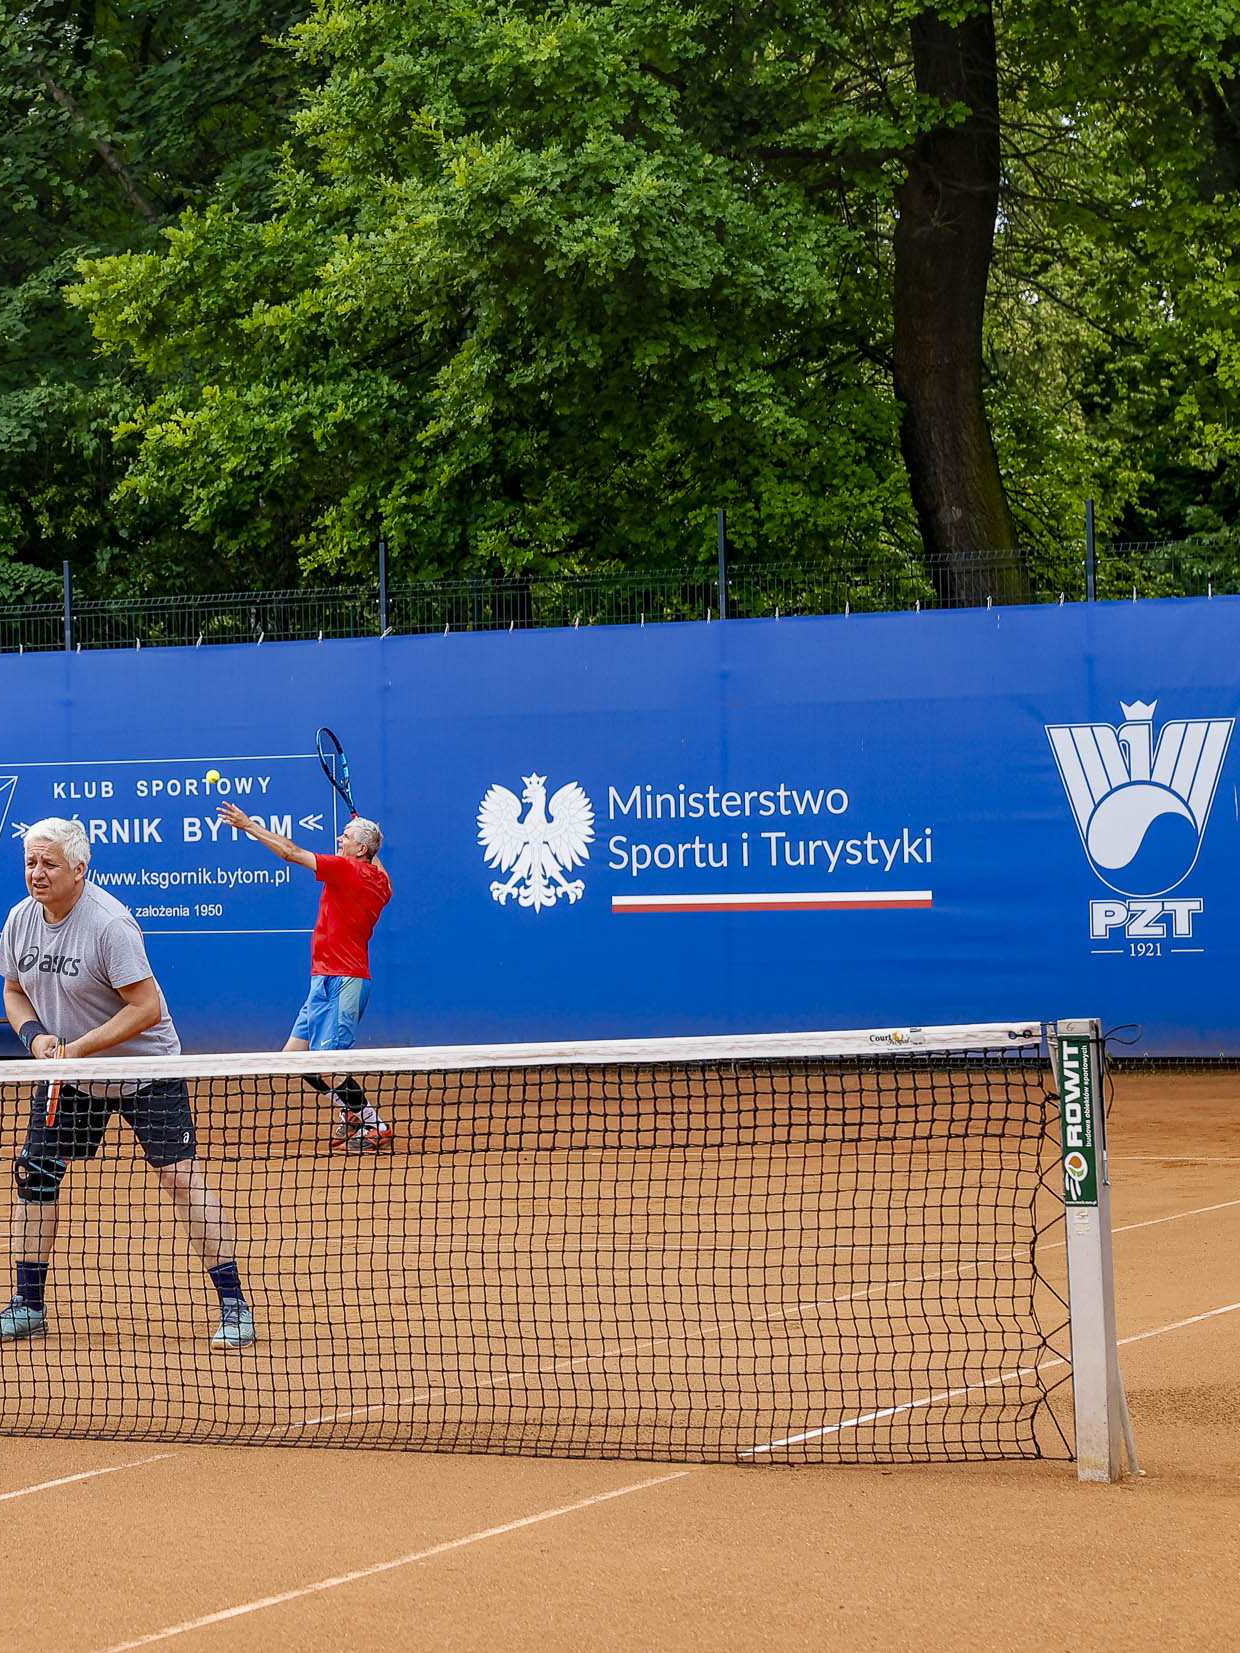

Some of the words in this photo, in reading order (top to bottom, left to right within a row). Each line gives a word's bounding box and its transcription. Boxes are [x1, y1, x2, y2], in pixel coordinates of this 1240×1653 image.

[53, 781, 114, 799] KLUB
[136, 776, 271, 797] SPORTOWY
[608, 783, 849, 820] Ministerstwo
[71, 814, 163, 845] RNIK
[608, 835, 728, 877] Sportu
[741, 831, 749, 867] i
[761, 827, 933, 873] Turystyki
[135, 905, 190, 918] założenia
[194, 904, 223, 917] 1950
[1089, 898, 1204, 939] PZT
[1130, 943, 1163, 957] 1921
[869, 1034, 892, 1042] Court
[1081, 1045, 1090, 1085] sportowych
[1062, 1040, 1083, 1148] ROWIT
